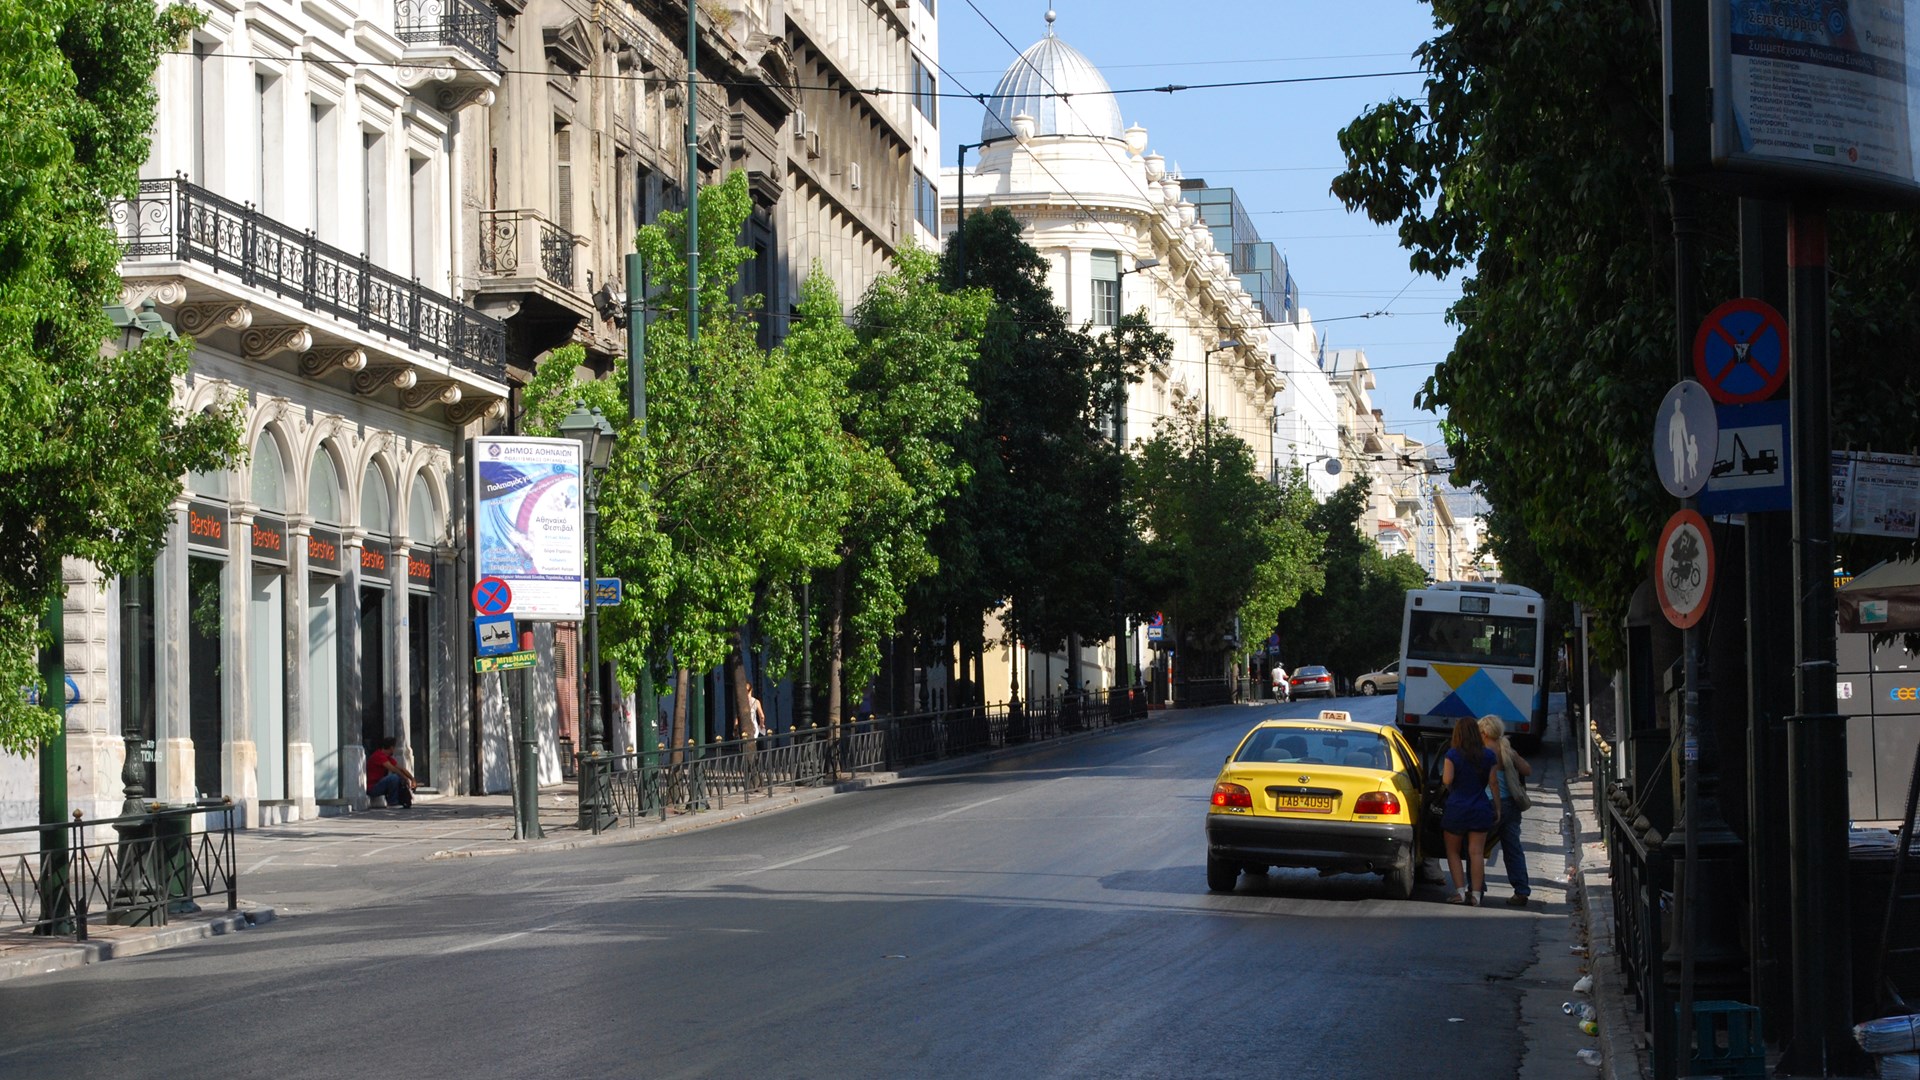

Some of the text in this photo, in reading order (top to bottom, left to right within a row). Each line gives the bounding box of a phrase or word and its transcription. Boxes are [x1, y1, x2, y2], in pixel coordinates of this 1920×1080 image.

[1748, 8, 1825, 36] Σεπτέμβριος
[1748, 39, 1808, 58] Συμμετέχουν:
[1810, 47, 1844, 63] Μουσικά
[504, 447, 572, 457] ΔΗΜΟΣ ΑΘΗΝΑΙΩΝ
[487, 475, 522, 492] Πολιτισμός
[190, 511, 221, 540] Bershka
[536, 516, 567, 524] Αθηναϊκό
[542, 524, 574, 532] Φεστιβάλ
[253, 524, 280, 550] Bershka
[309, 536, 334, 561] Bershka
[360, 545, 385, 570] Bershka
[408, 555, 431, 579] Bershka
[496, 653, 536, 664] ΜΠΕΝΑΚΗ
[1324, 712, 1348, 720] ΤΑΞΙ
